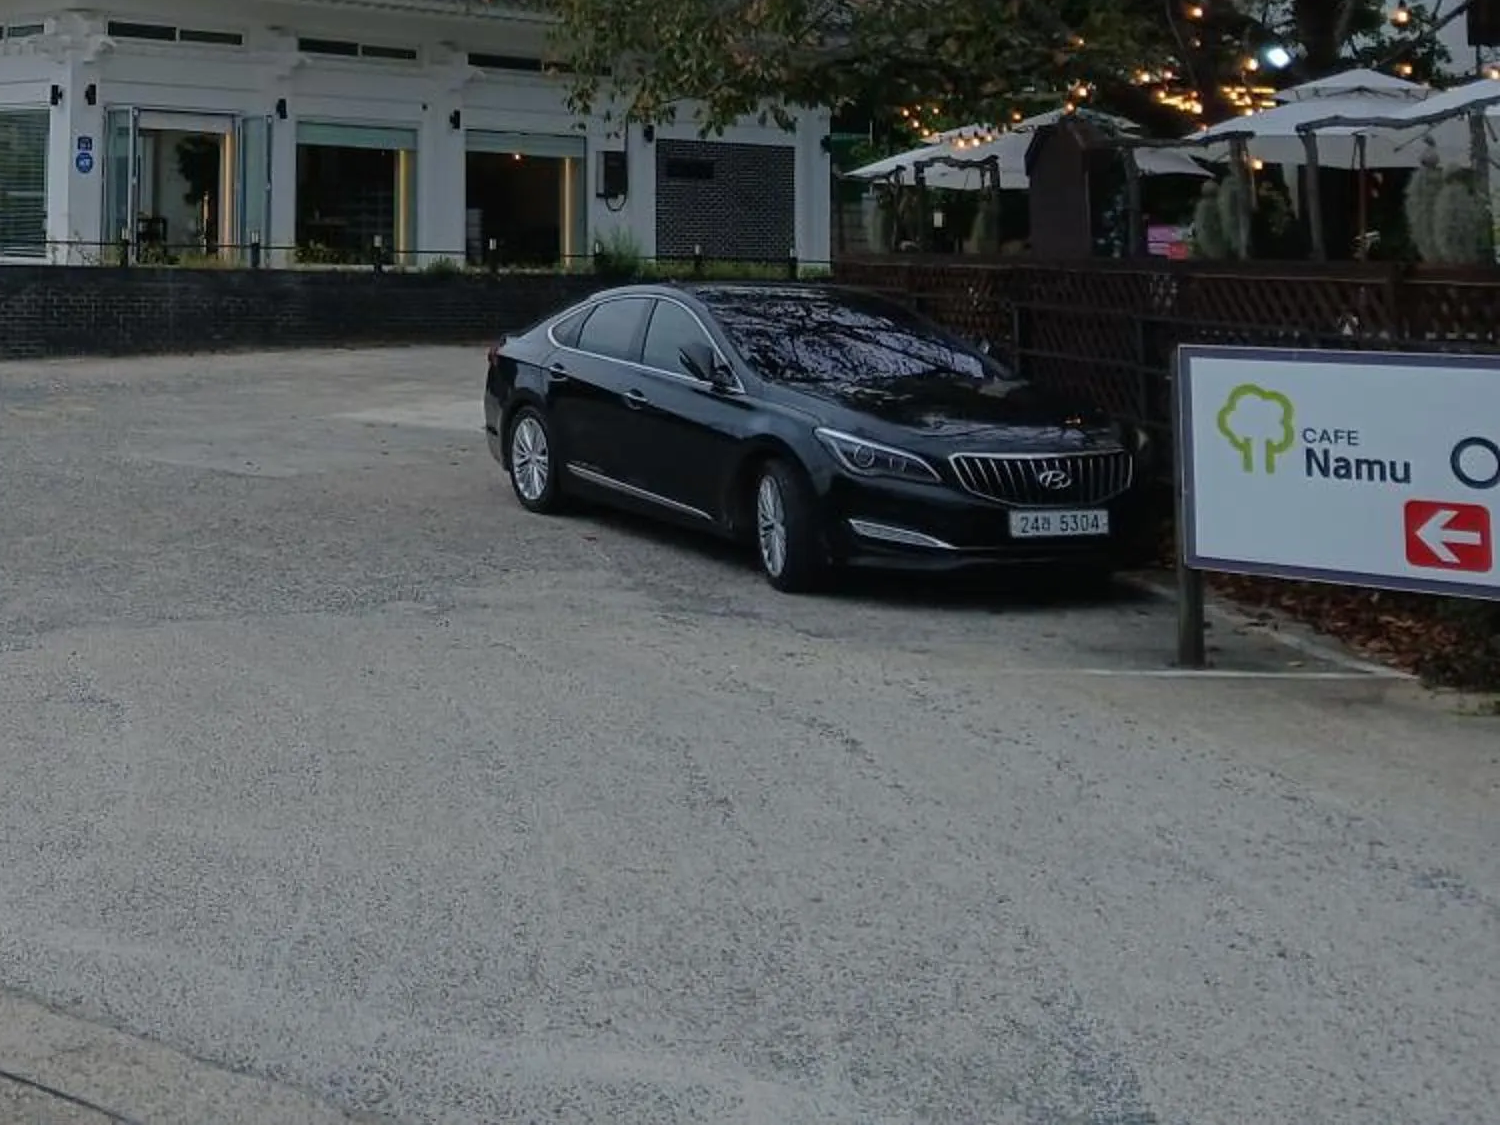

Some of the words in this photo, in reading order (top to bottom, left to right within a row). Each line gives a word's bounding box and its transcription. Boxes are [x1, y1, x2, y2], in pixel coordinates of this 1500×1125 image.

[1303, 428, 1360, 447] CAFE
[1304, 448, 1412, 484] Namu
[1060, 514, 1100, 532] 5304
